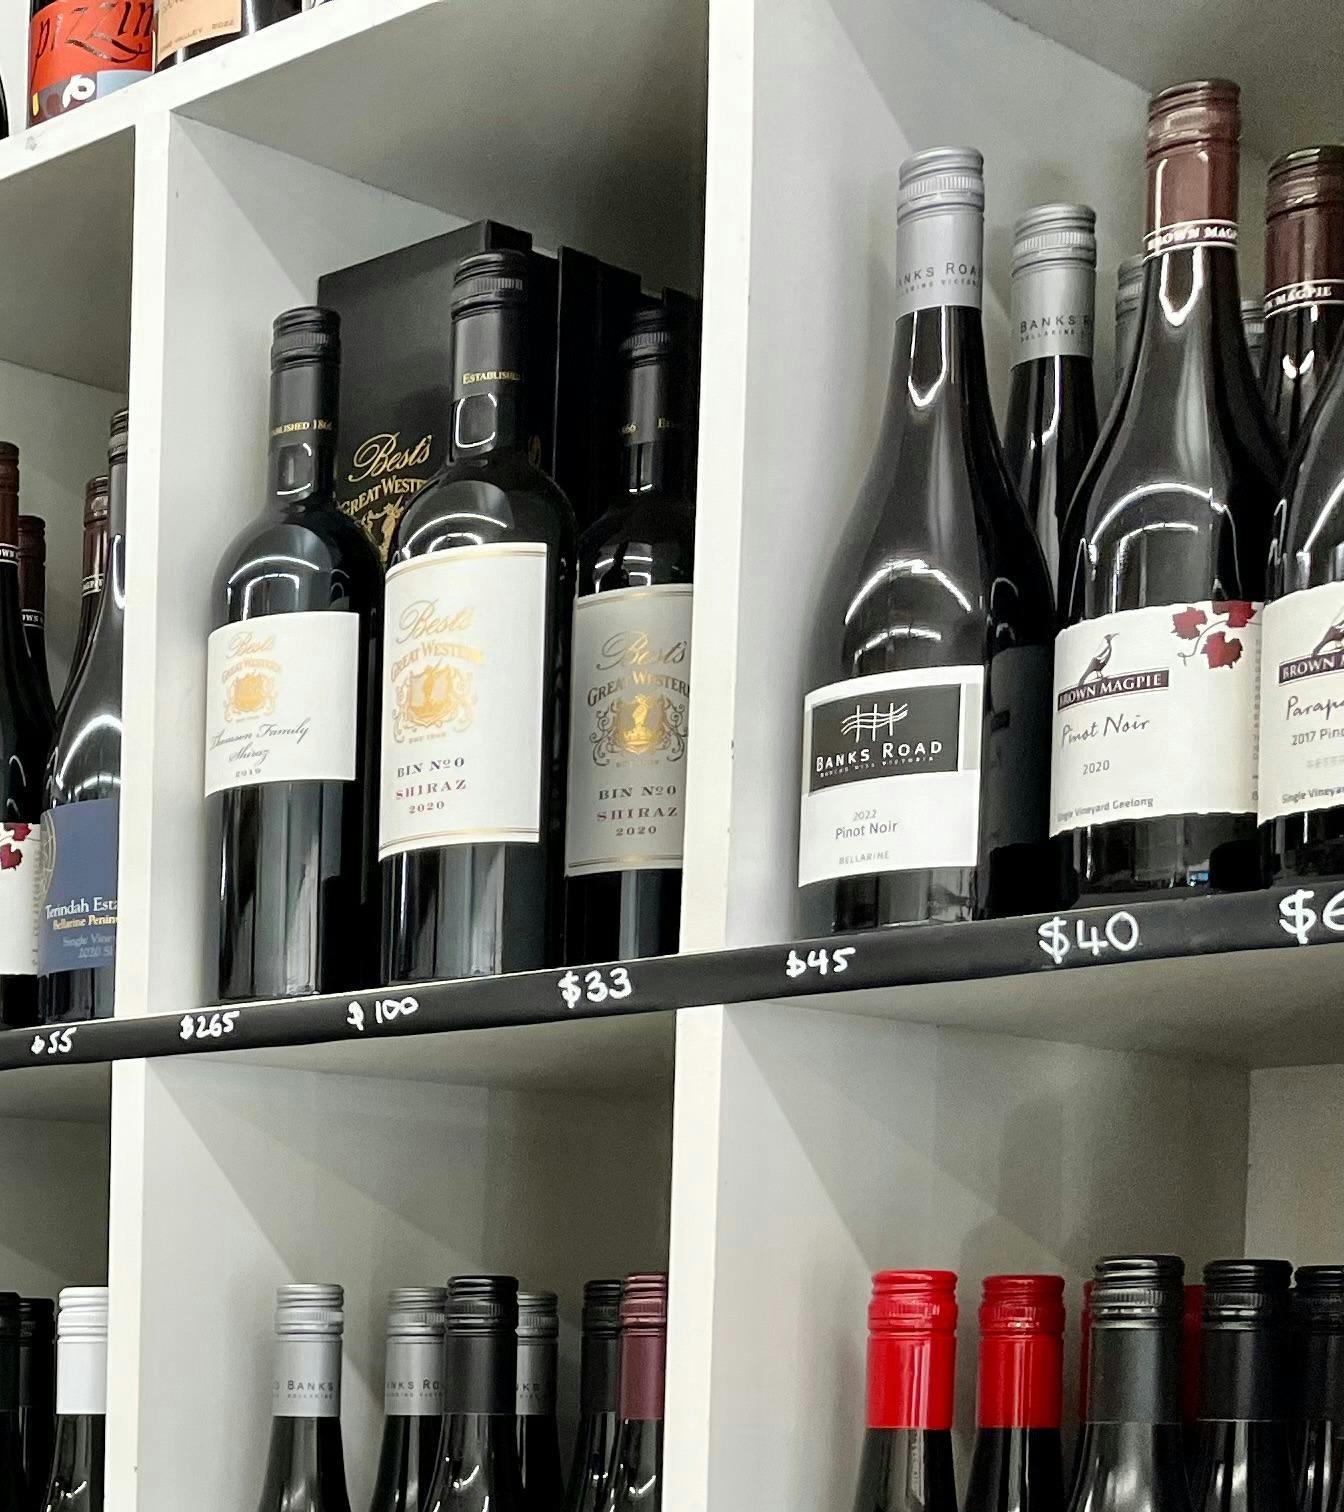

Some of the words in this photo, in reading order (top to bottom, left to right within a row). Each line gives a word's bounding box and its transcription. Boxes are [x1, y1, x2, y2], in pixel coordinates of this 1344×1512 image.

[1019, 315, 1076, 335] BANKS
[1281, 657, 1335, 679] BROWN
[1099, 671, 1163, 695] MAGPIE
[255, 717, 312, 746] Family
[1061, 720, 1100, 748] Pinot
[1103, 714, 1150, 734] Noir
[1291, 730, 1316, 746] 2017
[816, 748, 871, 773] BANKS
[882, 740, 944, 760] ROAD
[1082, 759, 1111, 775] 2020
[397, 759, 423, 779] BIN
[395, 778, 468, 801] SHIRAZ
[598, 785, 632, 801] BIN
[408, 800, 445, 815] 2020
[596, 806, 679, 823] SHIRAZ
[615, 825, 657, 837] 2020
[835, 822, 865, 840] Pinot
[867, 818, 899, 836] Noir
[838, 850, 890, 866] BELLARINE
[45, 899, 90, 919] Terindah
[1038, 910, 1141, 965] $40
[785, 946, 856, 979] $45
[558, 967, 632, 1009] $33
[179, 1010, 241, 1040] $265
[31, 1027, 78, 1055] $55
